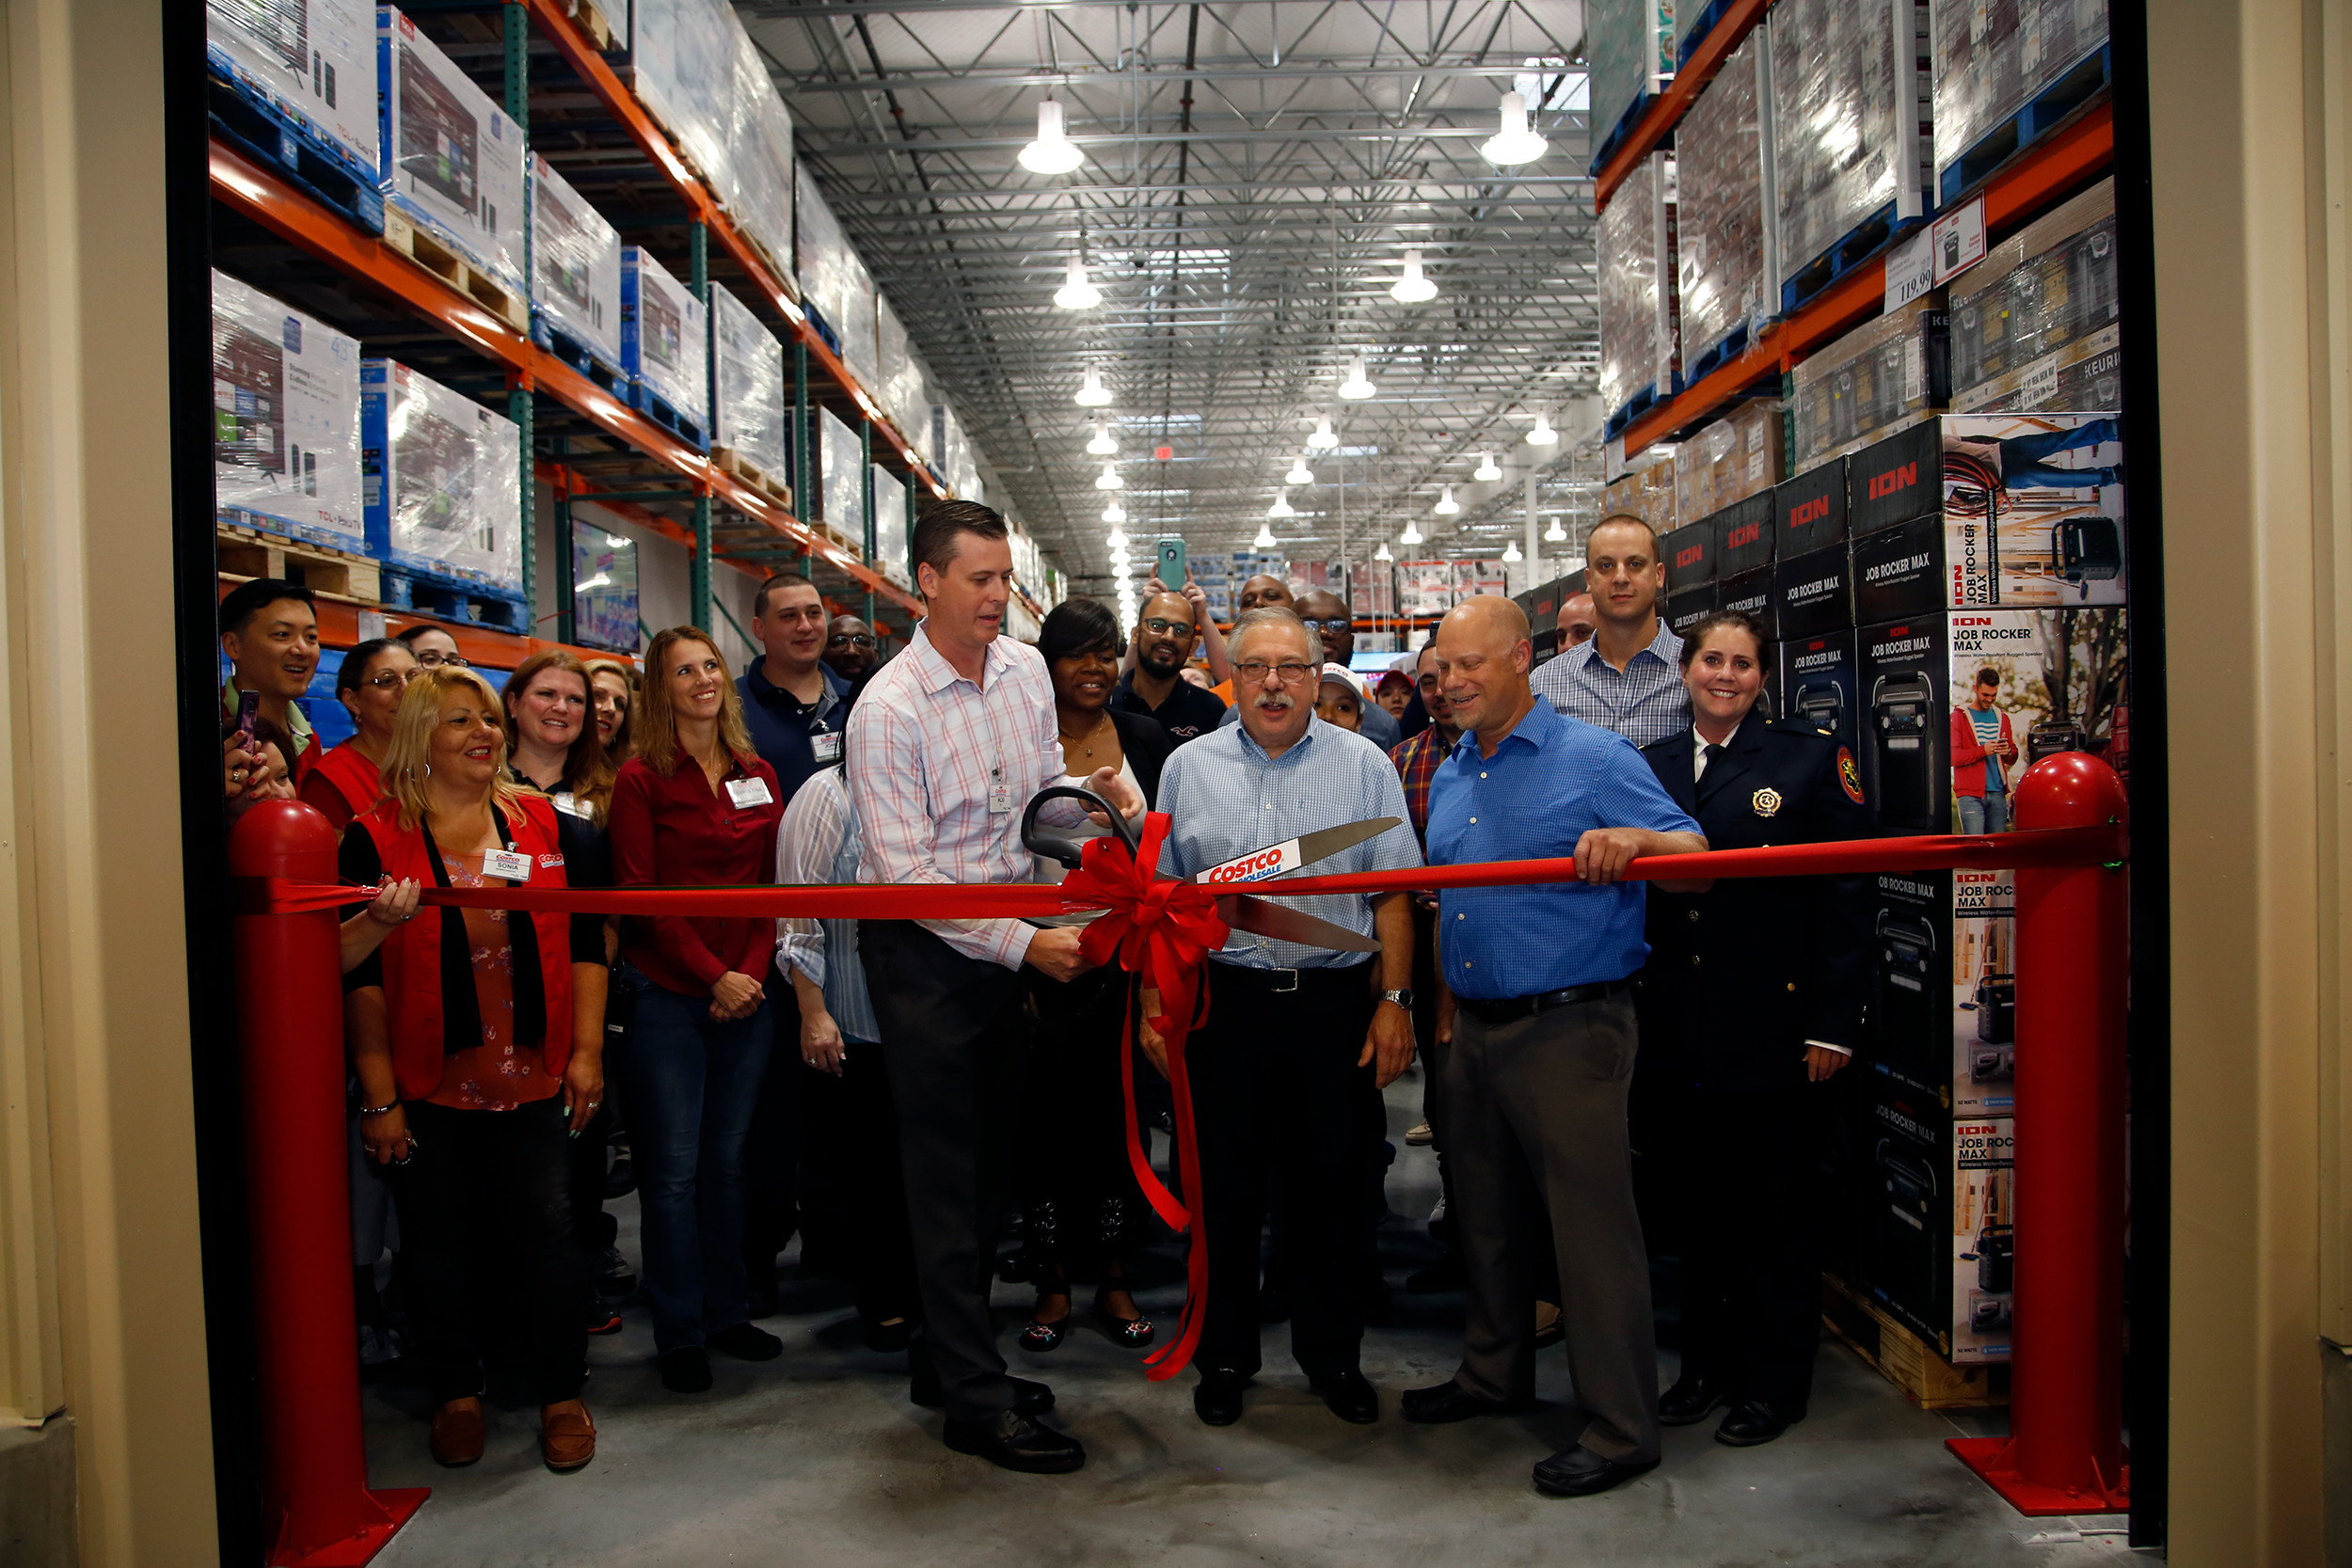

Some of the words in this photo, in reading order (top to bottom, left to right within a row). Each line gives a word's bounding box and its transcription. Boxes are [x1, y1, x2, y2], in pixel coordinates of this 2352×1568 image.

[1900, 269, 1931, 302] 119.99
[2085, 351, 2121, 378] KEURI
[1868, 461, 1917, 500] ION
[1790, 494, 1829, 528] ION
[1727, 521, 1759, 549] ION
[1676, 544, 1703, 568] ION
[1964, 523, 1976, 575] ROCKER
[1865, 566, 1880, 581] JOB
[1881, 559, 1909, 578] ROCKER
[1911, 552, 1930, 570] MAX
[1788, 587, 1799, 600] JOB
[1800, 580, 1822, 597] ROCKER
[1823, 576, 1839, 592] MAX
[1954, 564, 1963, 605] ION
[1966, 578, 1977, 604] JOB
[1978, 574, 1988, 603] MAX
[1735, 597, 1754, 610] ROCKER
[1755, 594, 1767, 607] MAX
[1890, 626, 1908, 637] ION
[1953, 617, 1991, 626] ION
[1953, 629, 1978, 640] JOB
[1982, 628, 2031, 639] ROCKER
[1809, 641, 1824, 651] ION
[1871, 643, 1884, 657] JOB
[1885, 640, 1912, 656] ROCKER
[1913, 636, 1930, 651] MAX
[1954, 641, 1982, 651] MAX
[1795, 657, 1804, 669] JOB
[1805, 653, 1826, 667] ROCKER
[1827, 650, 1841, 663] MAX
[496, 854, 520, 863] COSTCO
[497, 862, 518, 870] SONIA
[1209, 848, 1282, 882] COSTCO
[1235, 863, 1281, 882] HOLESALE
[1957, 874, 1995, 882] ION
[1879, 876, 1888, 889] OB
[1889, 878, 1915, 895] ROCKER
[1917, 883, 1934, 898] MAX
[1958, 886, 1982, 896] JOB
[1986, 885, 2013, 895] ROC
[1959, 897, 1986, 907] MAX
[1876, 1103, 1889, 1118] JOB
[1890, 1110, 1916, 1134] ROCKER
[1918, 1124, 1936, 1144] MAX
[1958, 1126, 1996, 1135] ION
[1959, 1138, 1983, 1148] JOB
[1987, 1137, 2013, 1148] ROC
[1959, 1149, 1987, 1159] MAX
